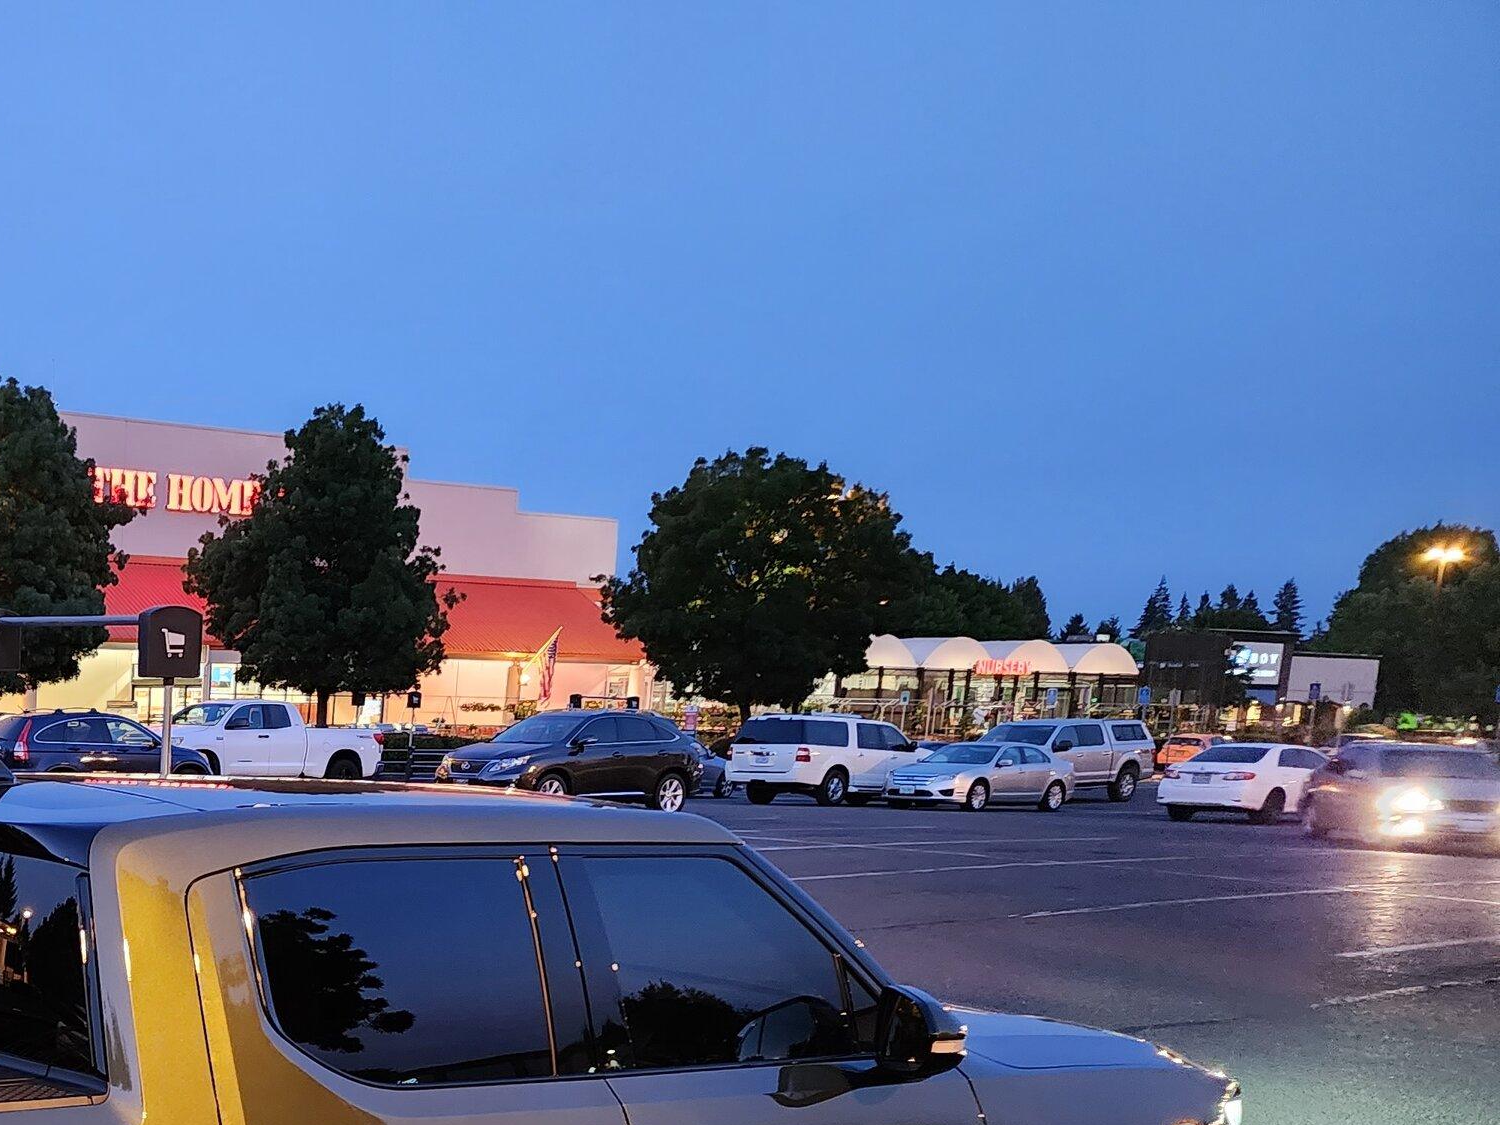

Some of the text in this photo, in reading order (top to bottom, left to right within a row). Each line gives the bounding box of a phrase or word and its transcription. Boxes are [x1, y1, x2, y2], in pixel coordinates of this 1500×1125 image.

[89, 467, 261, 516] THE HOME
[975, 659, 1034, 676] NURSERY
